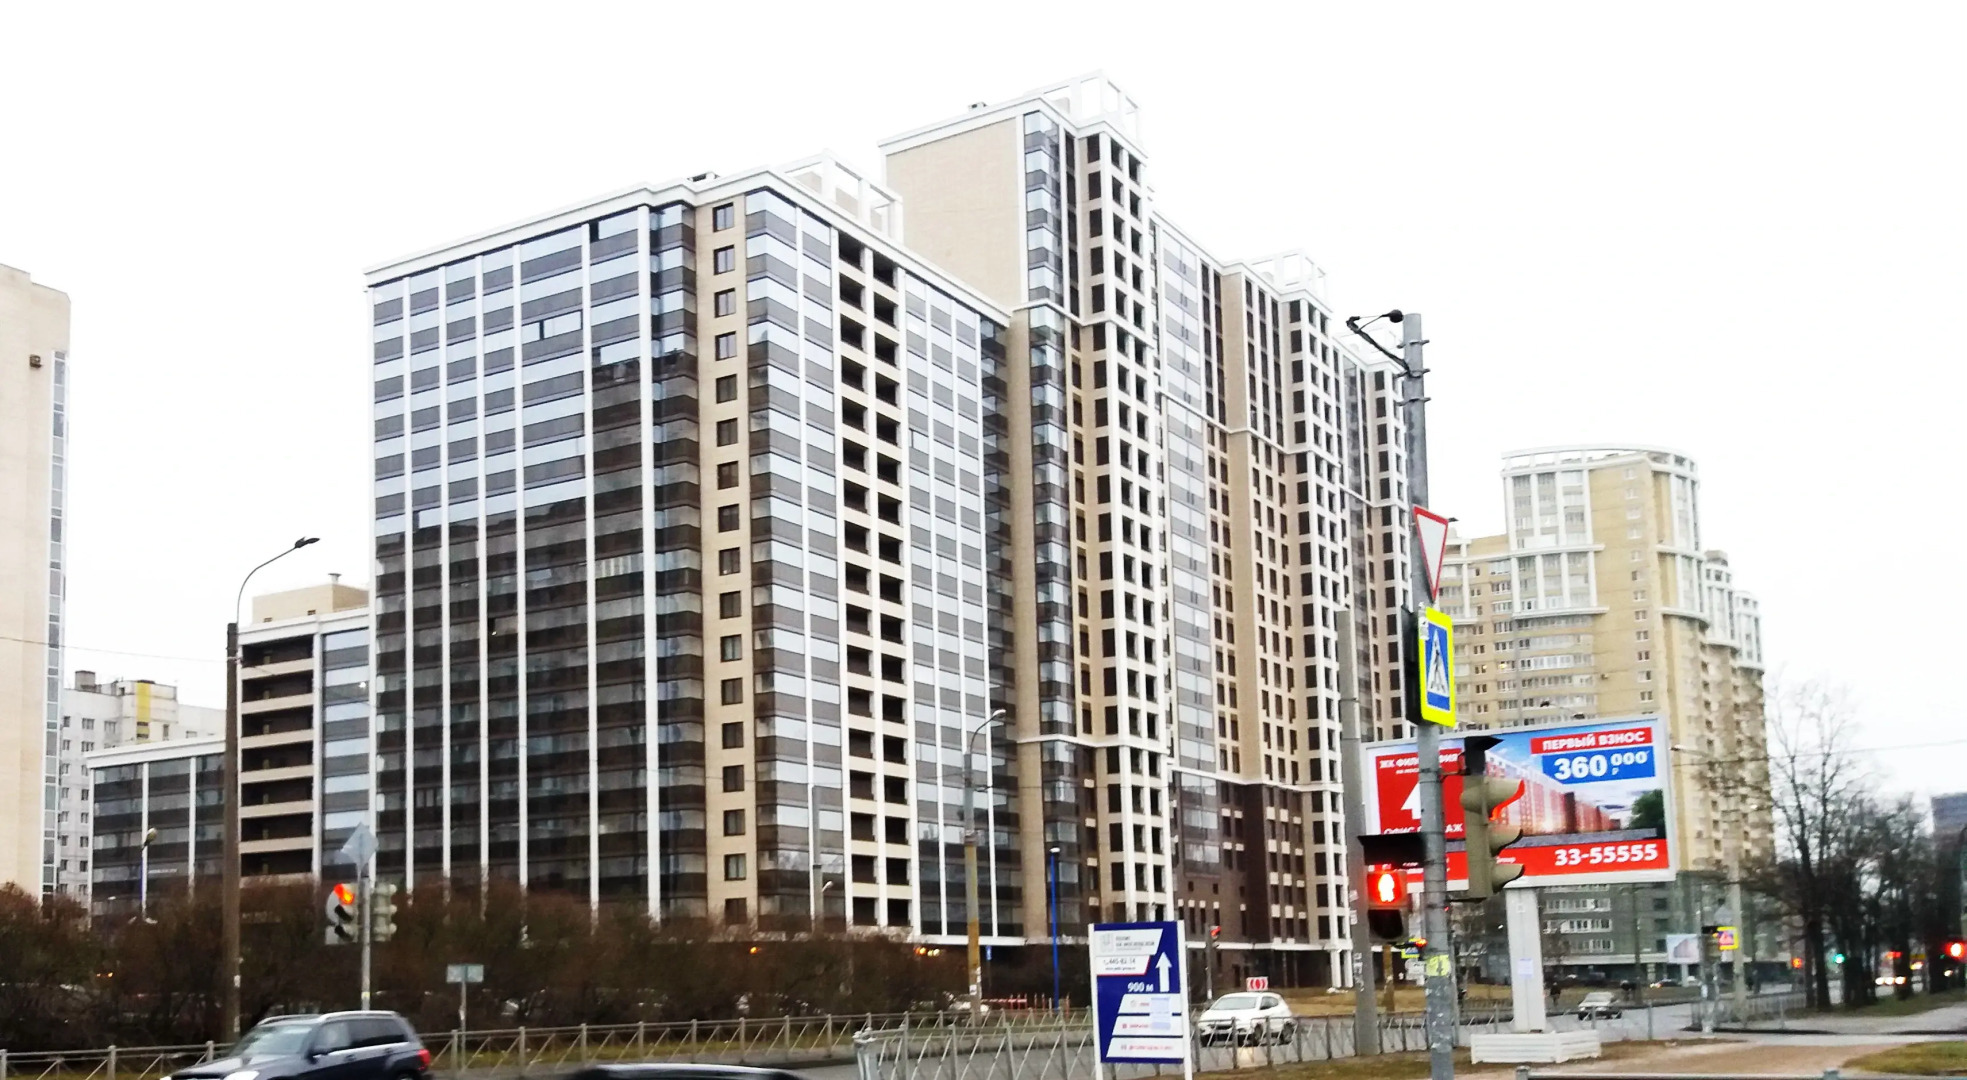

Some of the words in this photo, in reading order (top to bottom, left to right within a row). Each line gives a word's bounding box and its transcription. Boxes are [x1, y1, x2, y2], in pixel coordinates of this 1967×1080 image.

[1542, 733, 1596, 751] ПЕРВЫЙ
[1598, 731, 1646, 745] ВЗНОС
[1554, 755, 1608, 780] 360
[1610, 750, 1648, 766] 000
[1554, 844, 1658, 866] 33-55555
[1127, 981, 1145, 992] 900
